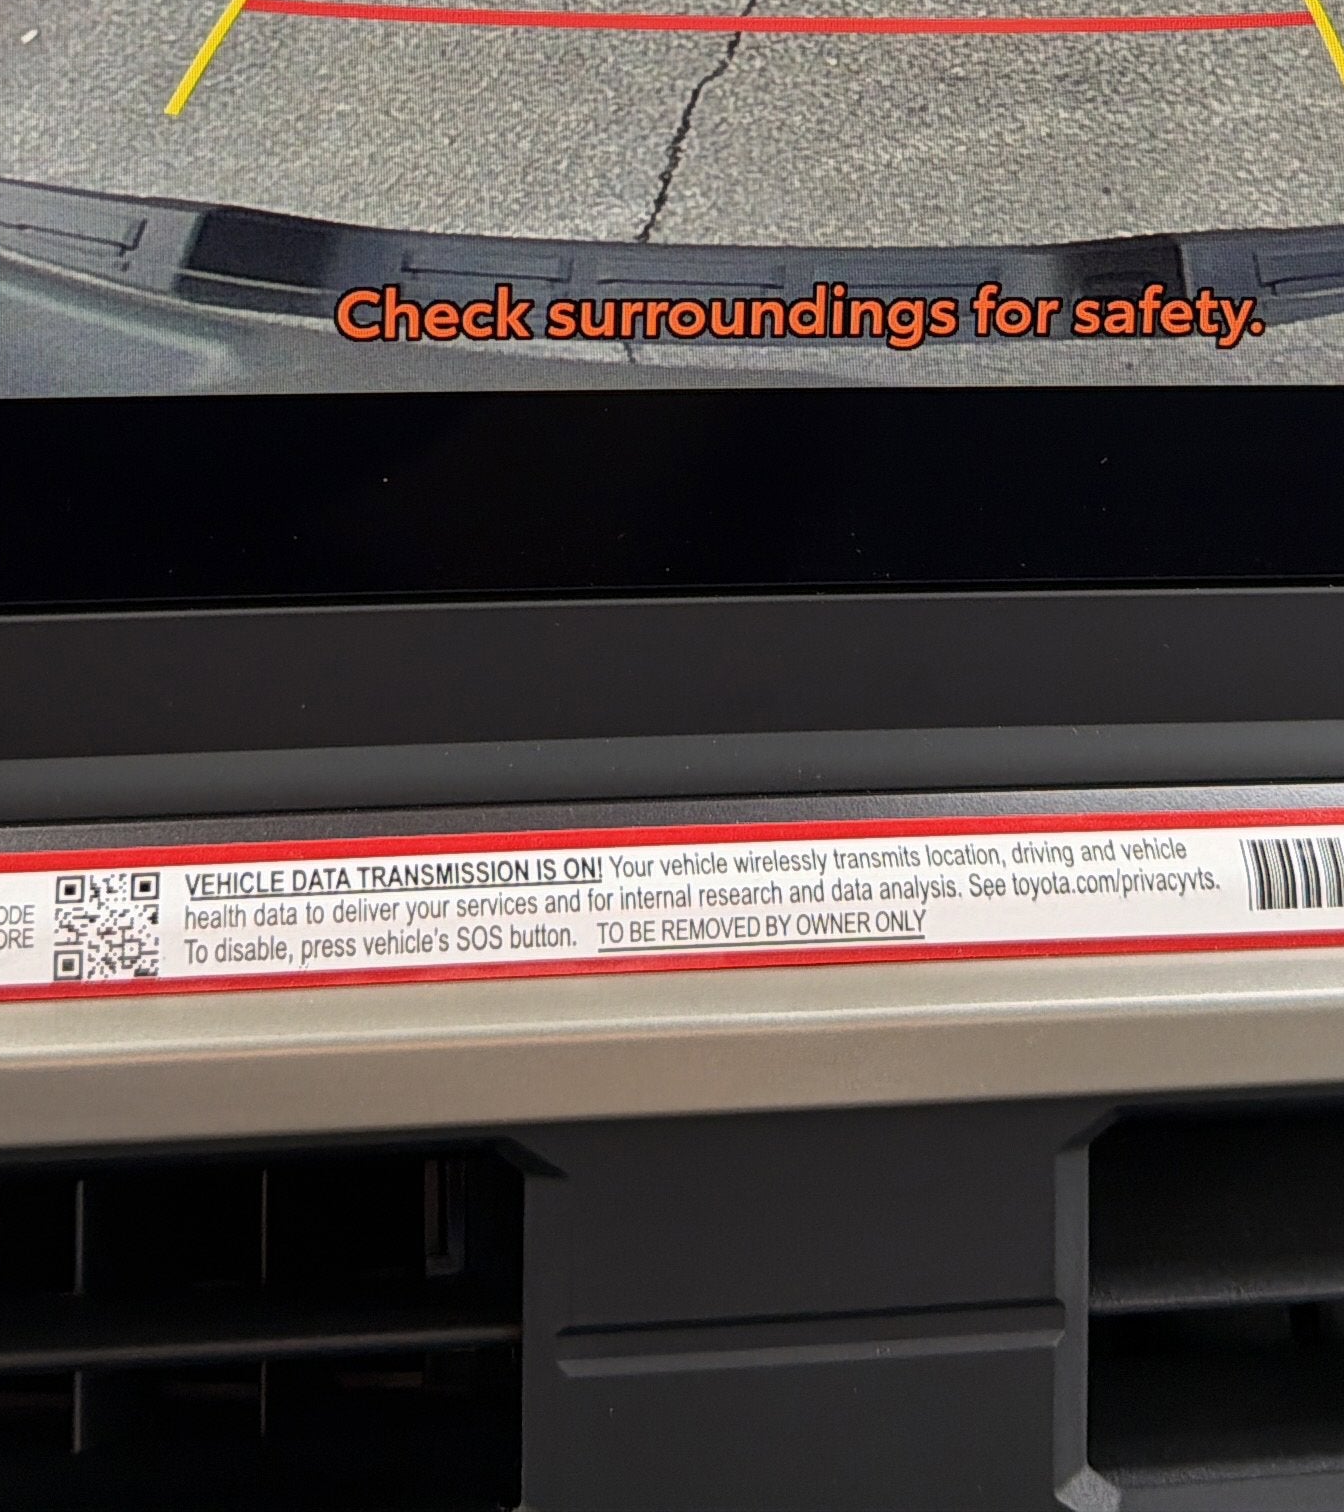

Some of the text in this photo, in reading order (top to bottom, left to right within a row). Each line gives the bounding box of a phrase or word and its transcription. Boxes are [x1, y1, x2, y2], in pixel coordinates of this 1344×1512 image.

[335, 282, 1265, 349] Check surroundings for safety.
[186, 837, 1187, 896] VEHICLE DATA TRANSMISSION IS ON! Your vehicle wirelessly transmits location, driving and vehicle
[185, 867, 1221, 929] health data to deliver your services and for internal research and data analysis. See toyota.com/privacyvts.
[184, 909, 926, 965] To disable, press vehicle's SOS button. TO BE REMOVED BY OWNER ONLY
